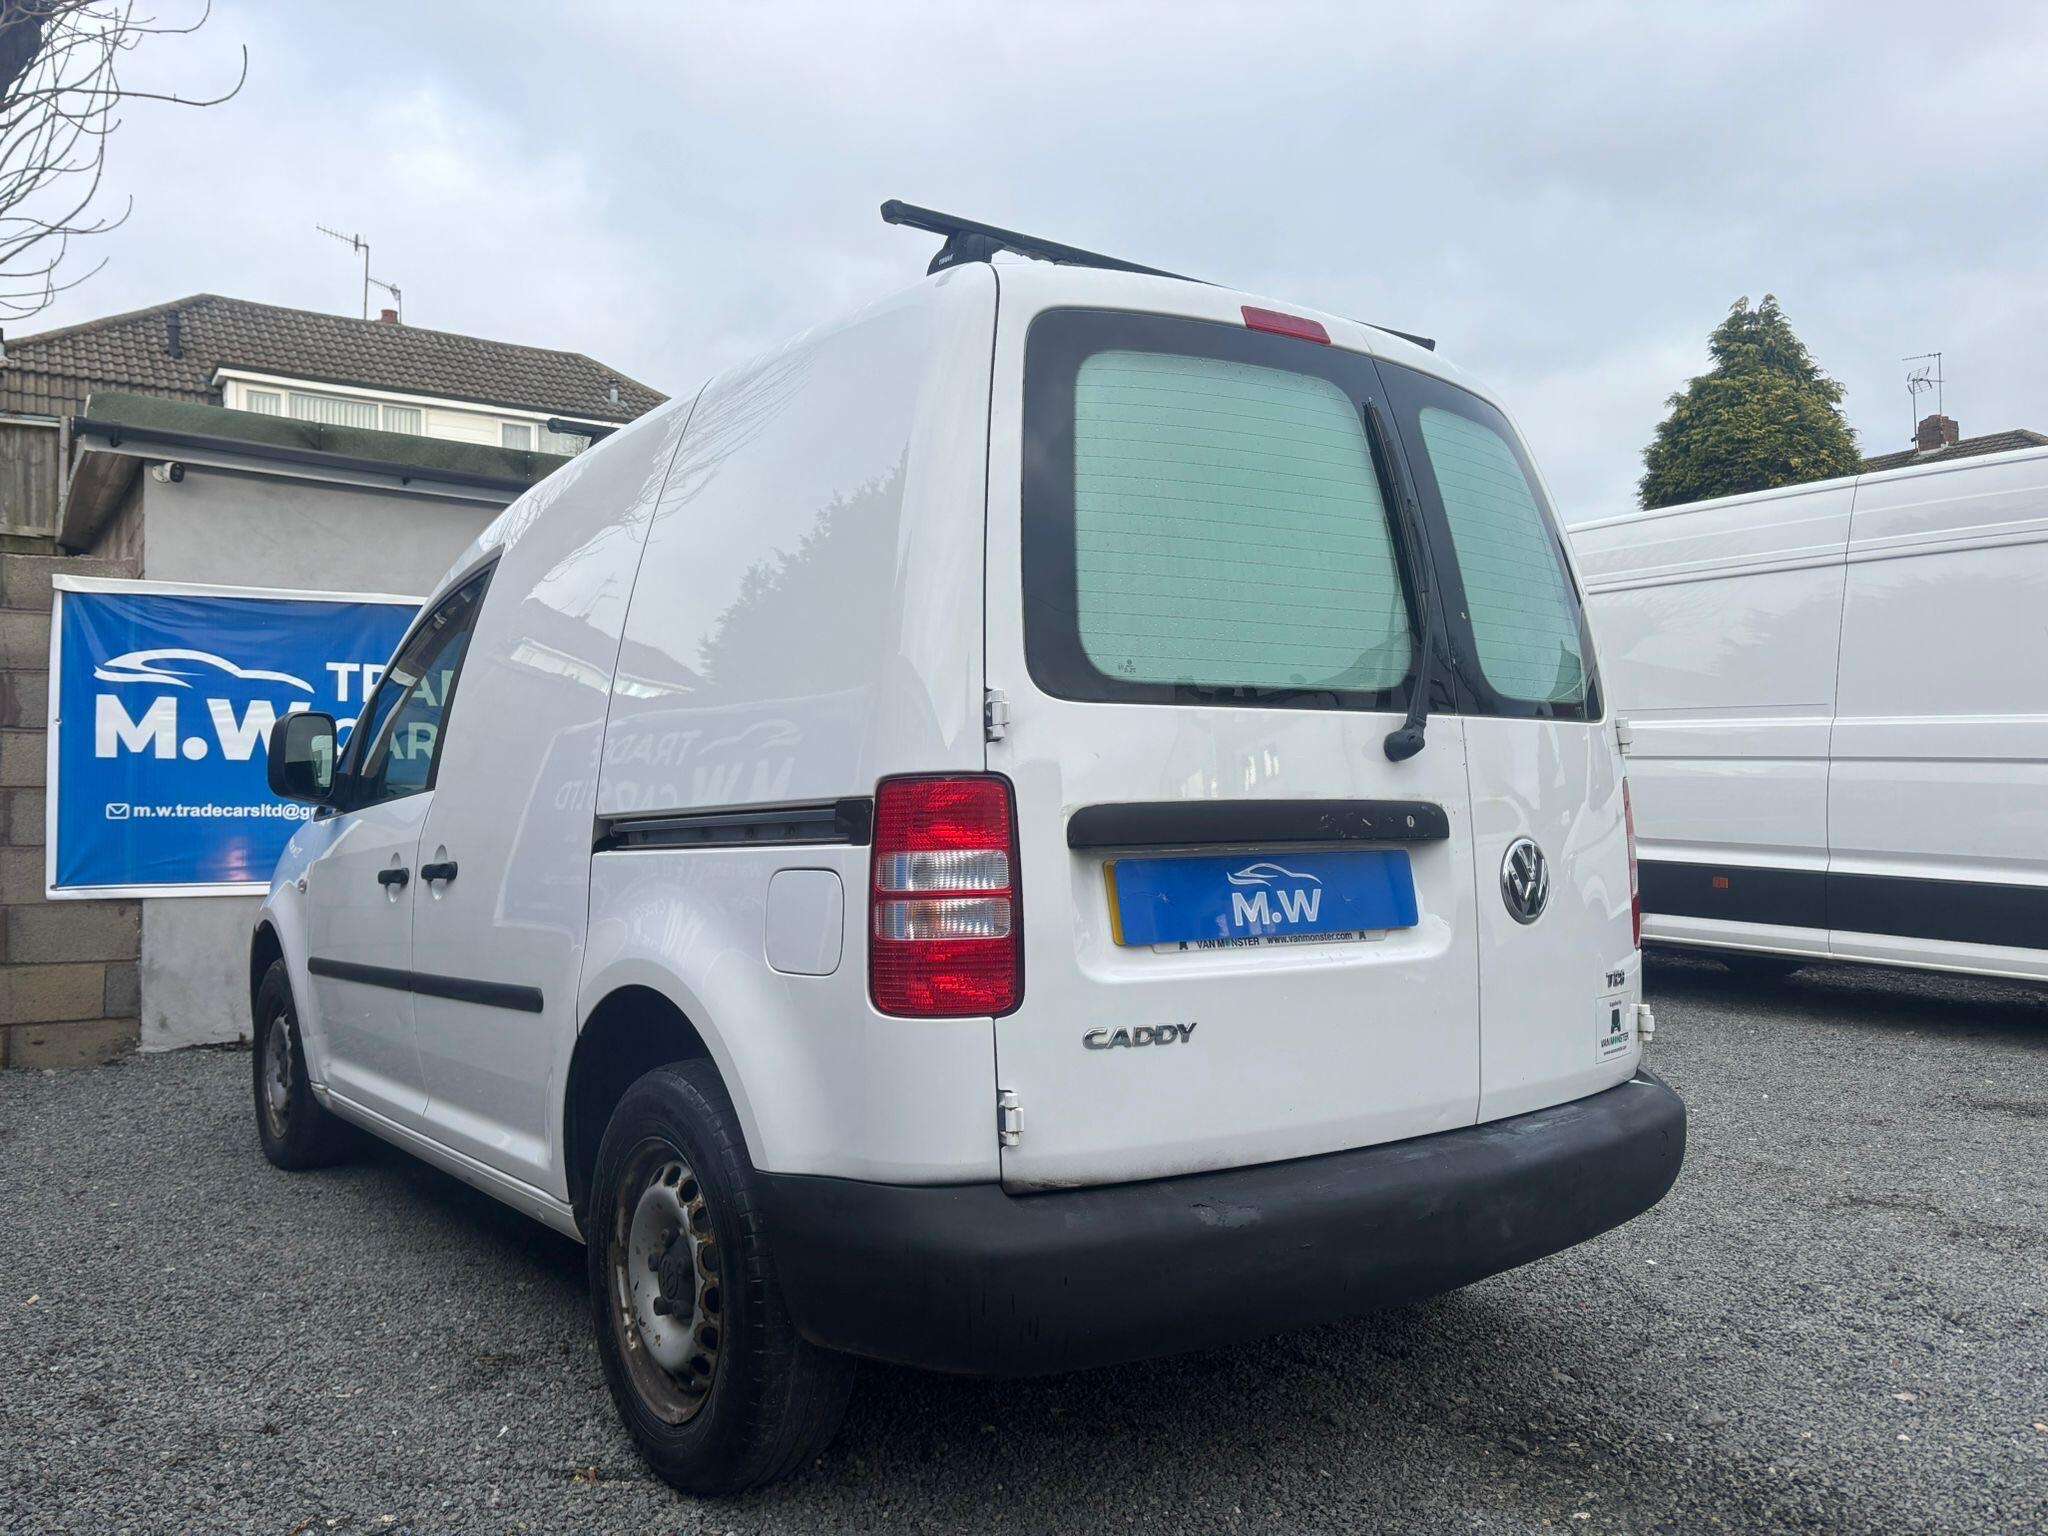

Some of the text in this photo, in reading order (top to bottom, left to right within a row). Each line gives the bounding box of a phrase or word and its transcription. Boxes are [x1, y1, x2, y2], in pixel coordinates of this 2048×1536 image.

[1231, 888, 1322, 927] M.W
[1266, 931, 1354, 945] www.vanmonster.com
[1082, 1022, 1198, 1050] CADDY
